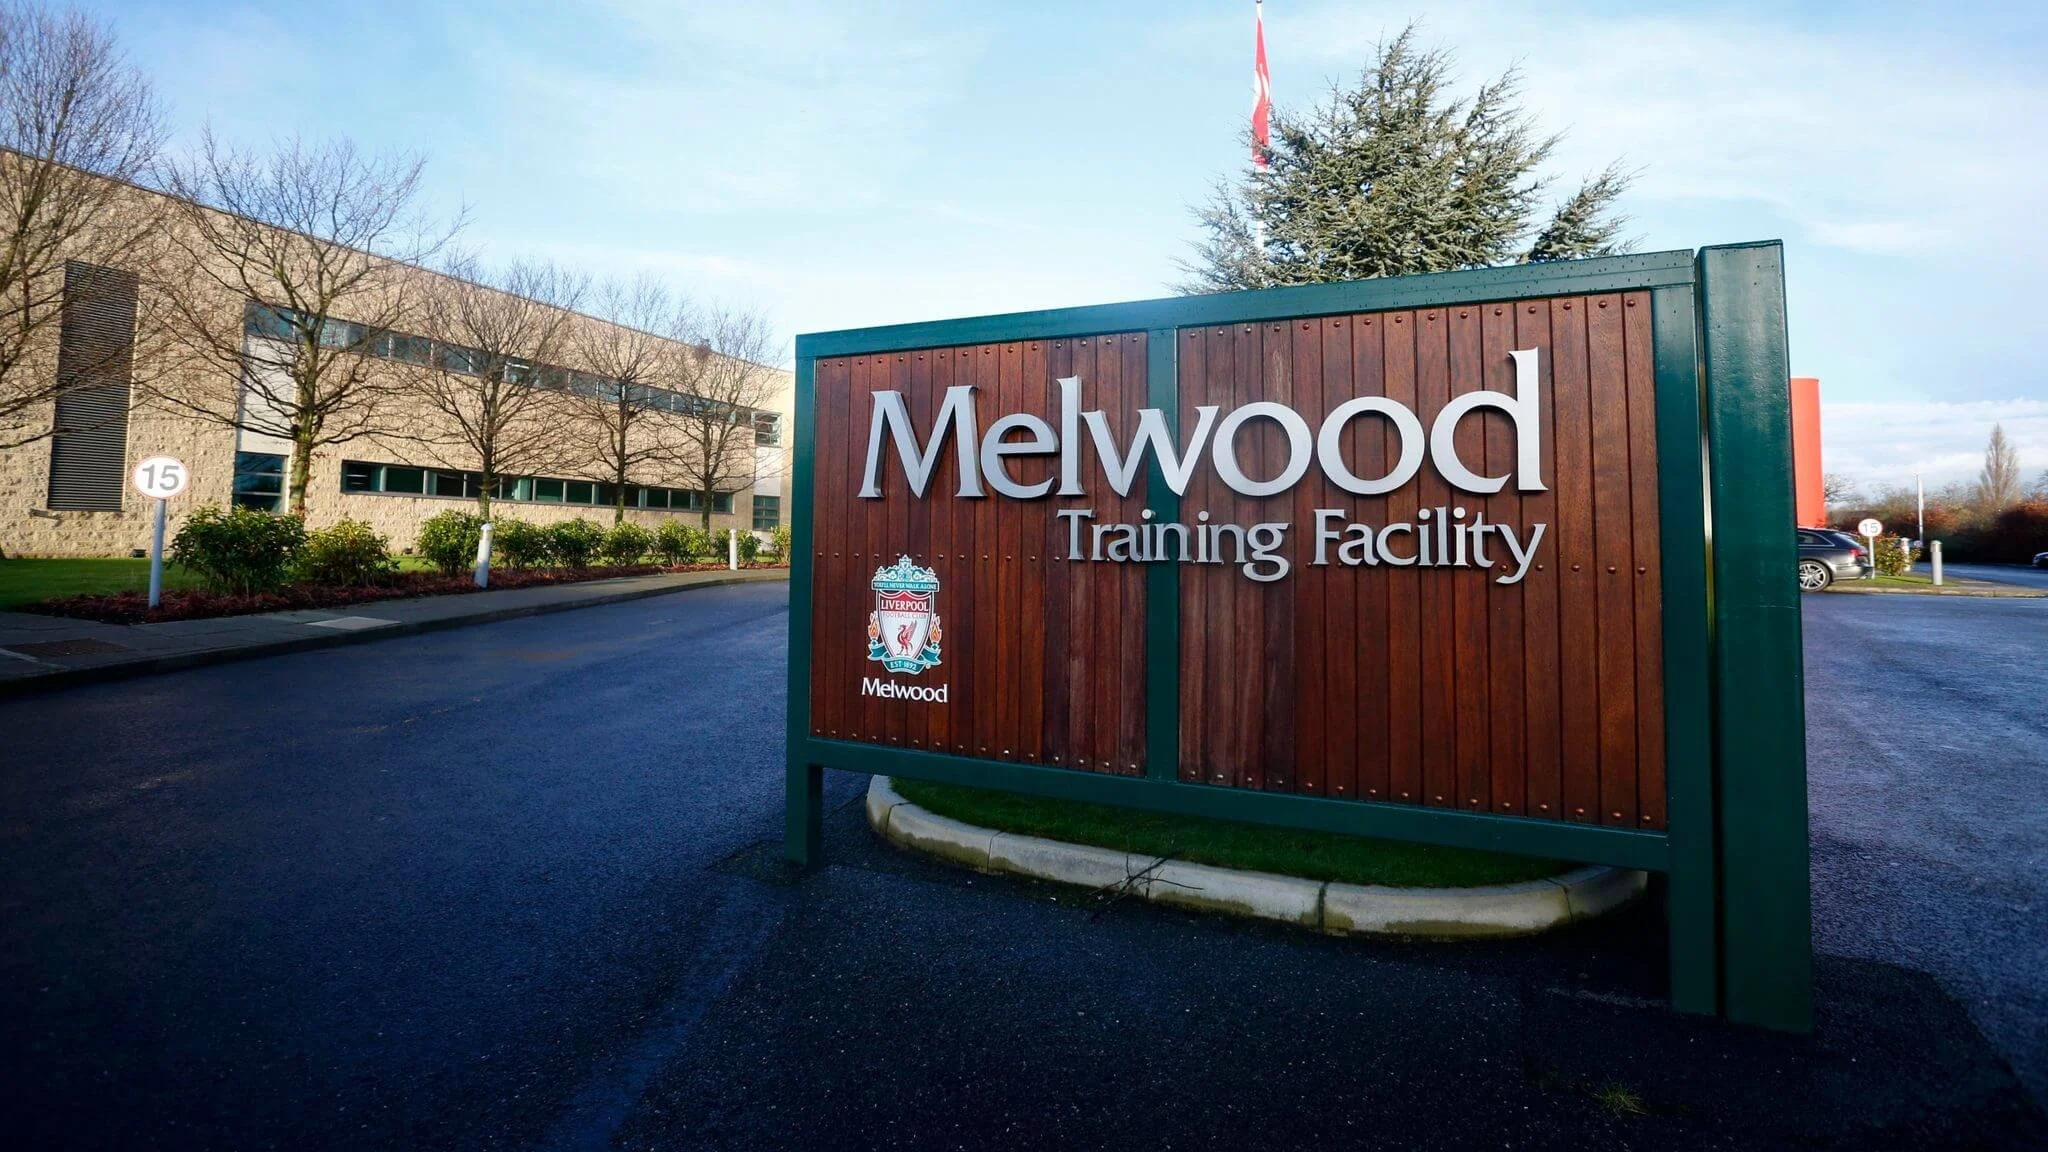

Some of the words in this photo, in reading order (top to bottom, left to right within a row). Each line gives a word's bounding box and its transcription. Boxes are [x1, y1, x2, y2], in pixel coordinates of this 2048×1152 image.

[857, 347, 1548, 500] Melwood
[142, 464, 180, 490] 15
[1863, 522, 1879, 535] 15
[1056, 509, 1293, 582] Training
[1313, 506, 1547, 584] Facility
[881, 600, 929, 611] LIVERPOOL
[861, 677, 948, 703] Melwood
